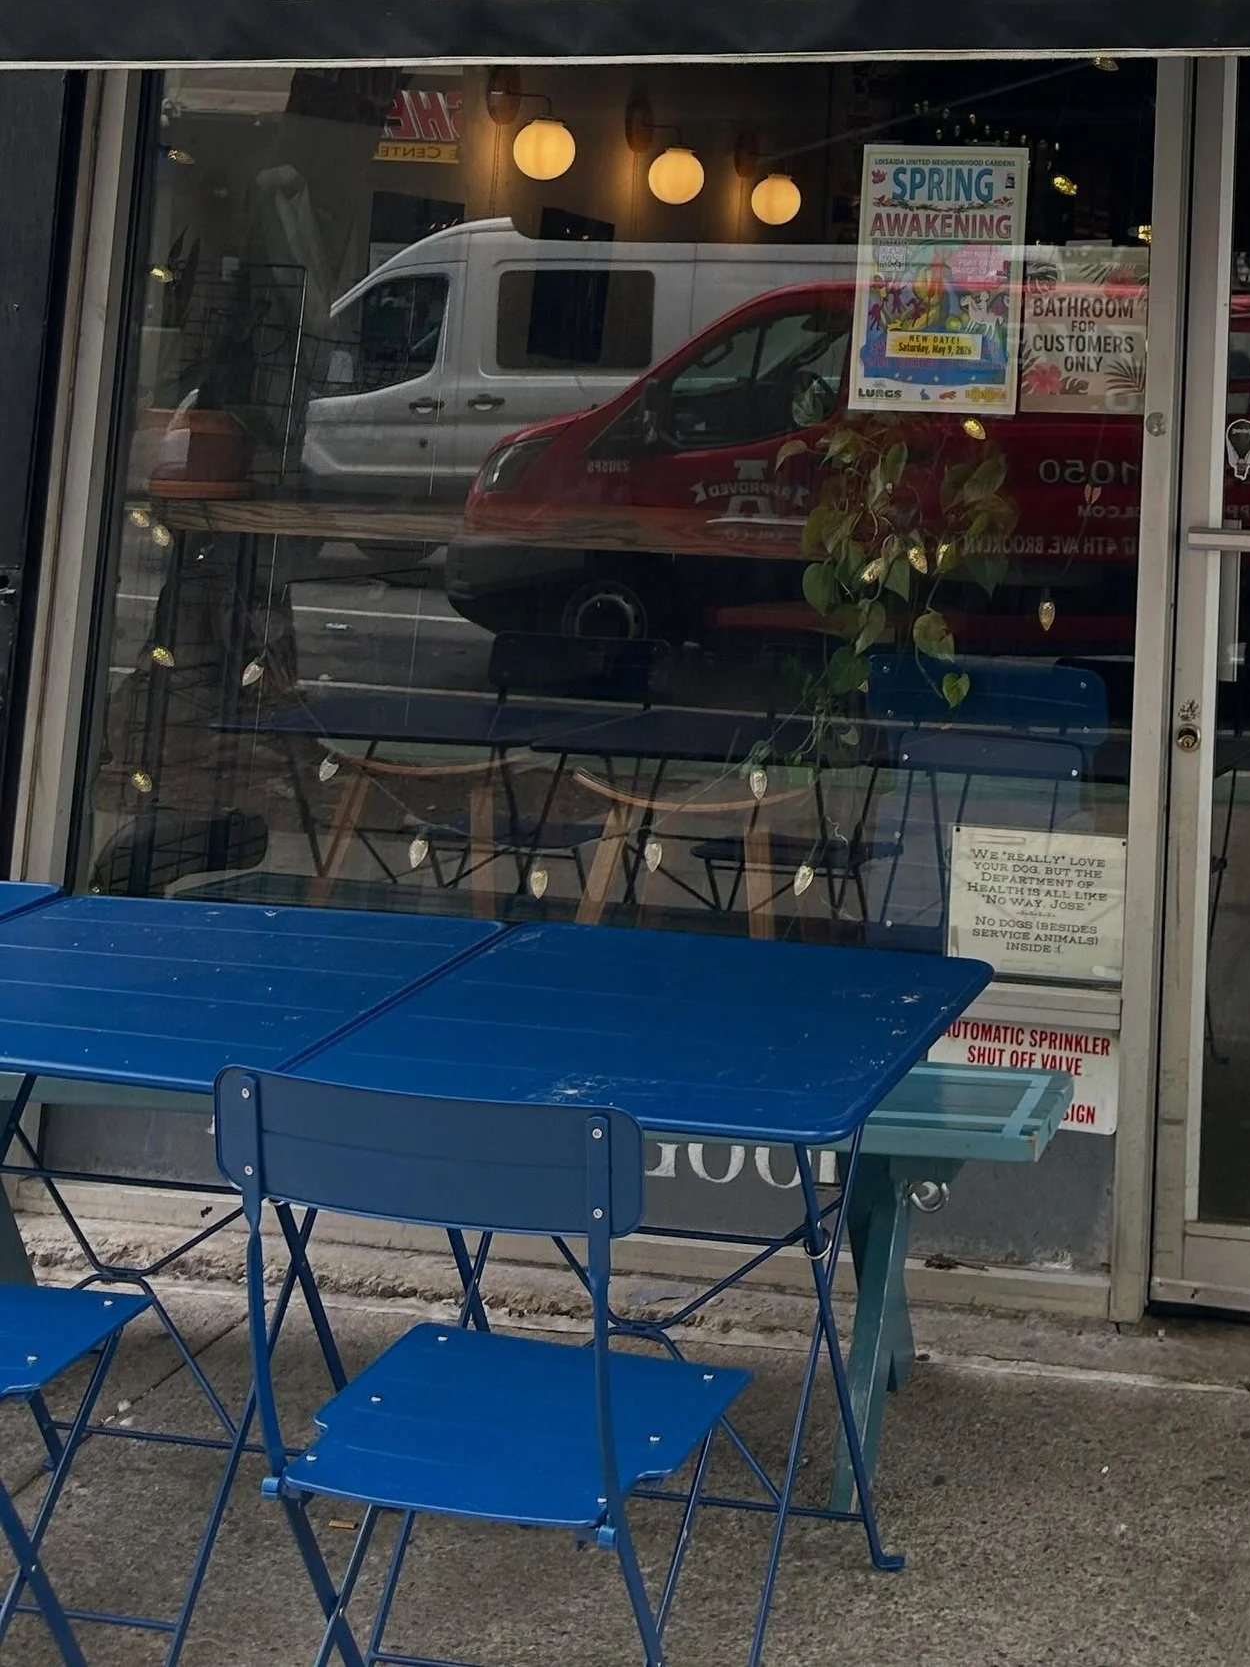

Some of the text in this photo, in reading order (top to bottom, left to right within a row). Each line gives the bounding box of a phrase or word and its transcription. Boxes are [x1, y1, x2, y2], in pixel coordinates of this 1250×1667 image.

[892, 167, 994, 202] SPRING
[869, 213, 1013, 239] AWAKENING
[1033, 297, 1134, 319] BATHROOM
[1071, 320, 1096, 333] FOR
[908, 335, 929, 343] NEW
[1032, 334, 1134, 353] CUSTOMERS
[1064, 355, 1104, 372] ONLY
[973, 861, 1009, 871] YOUR
[1045, 867, 1071, 877] BUT
[1075, 869, 1103, 879] THE
[1070, 857, 1106, 868] LOVE
[1044, 889, 1071, 899] ALL
[1075, 891, 1108, 902] LIKE
[999, 918, 1033, 929] DOGS
[972, 928, 1031, 941] SERVICE
[1006, 941, 1052, 954] INSIDE
[1029, 1029, 1111, 1056] SPRINKLER
[967, 1045, 1083, 1076] SHUT OFF VALVE
